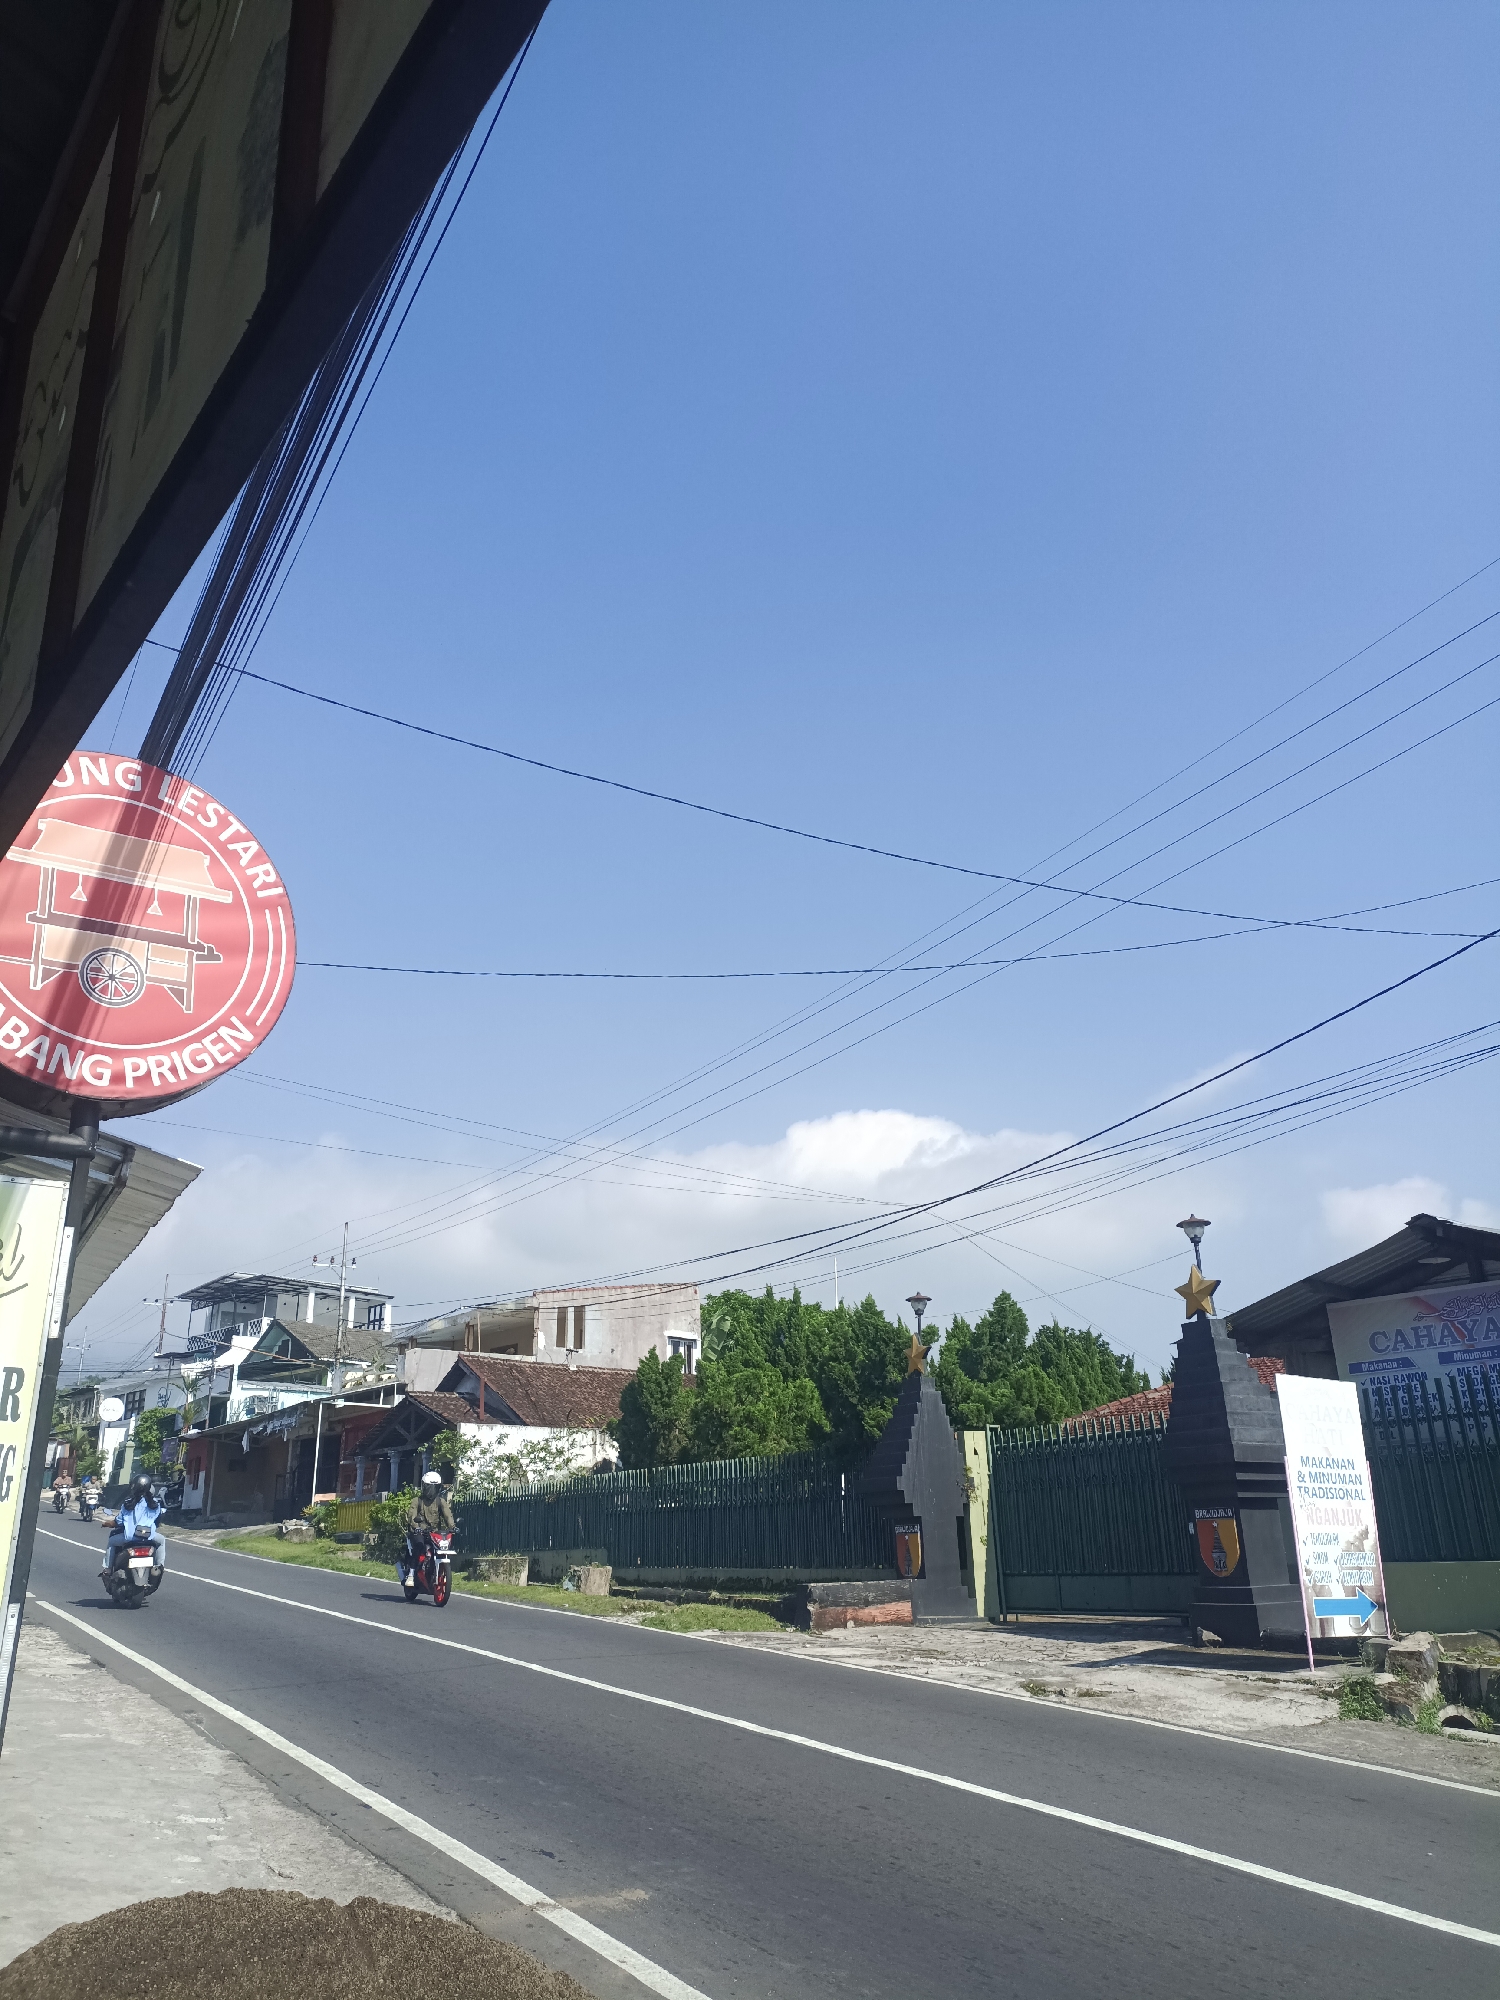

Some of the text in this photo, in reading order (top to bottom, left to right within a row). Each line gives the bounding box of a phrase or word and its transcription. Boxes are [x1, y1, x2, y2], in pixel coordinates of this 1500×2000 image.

[157, 774, 284, 898] LESTARI
[0, 1002, 254, 1088] BANG PRIGEN
[1368, 1316, 1500, 1354] CAHAYA
[1300, 1455, 1355, 1471] MAKANAN
[1297, 1470, 1363, 1486] & MINUMAN
[1296, 1485, 1367, 1501] TRADISIONAL
